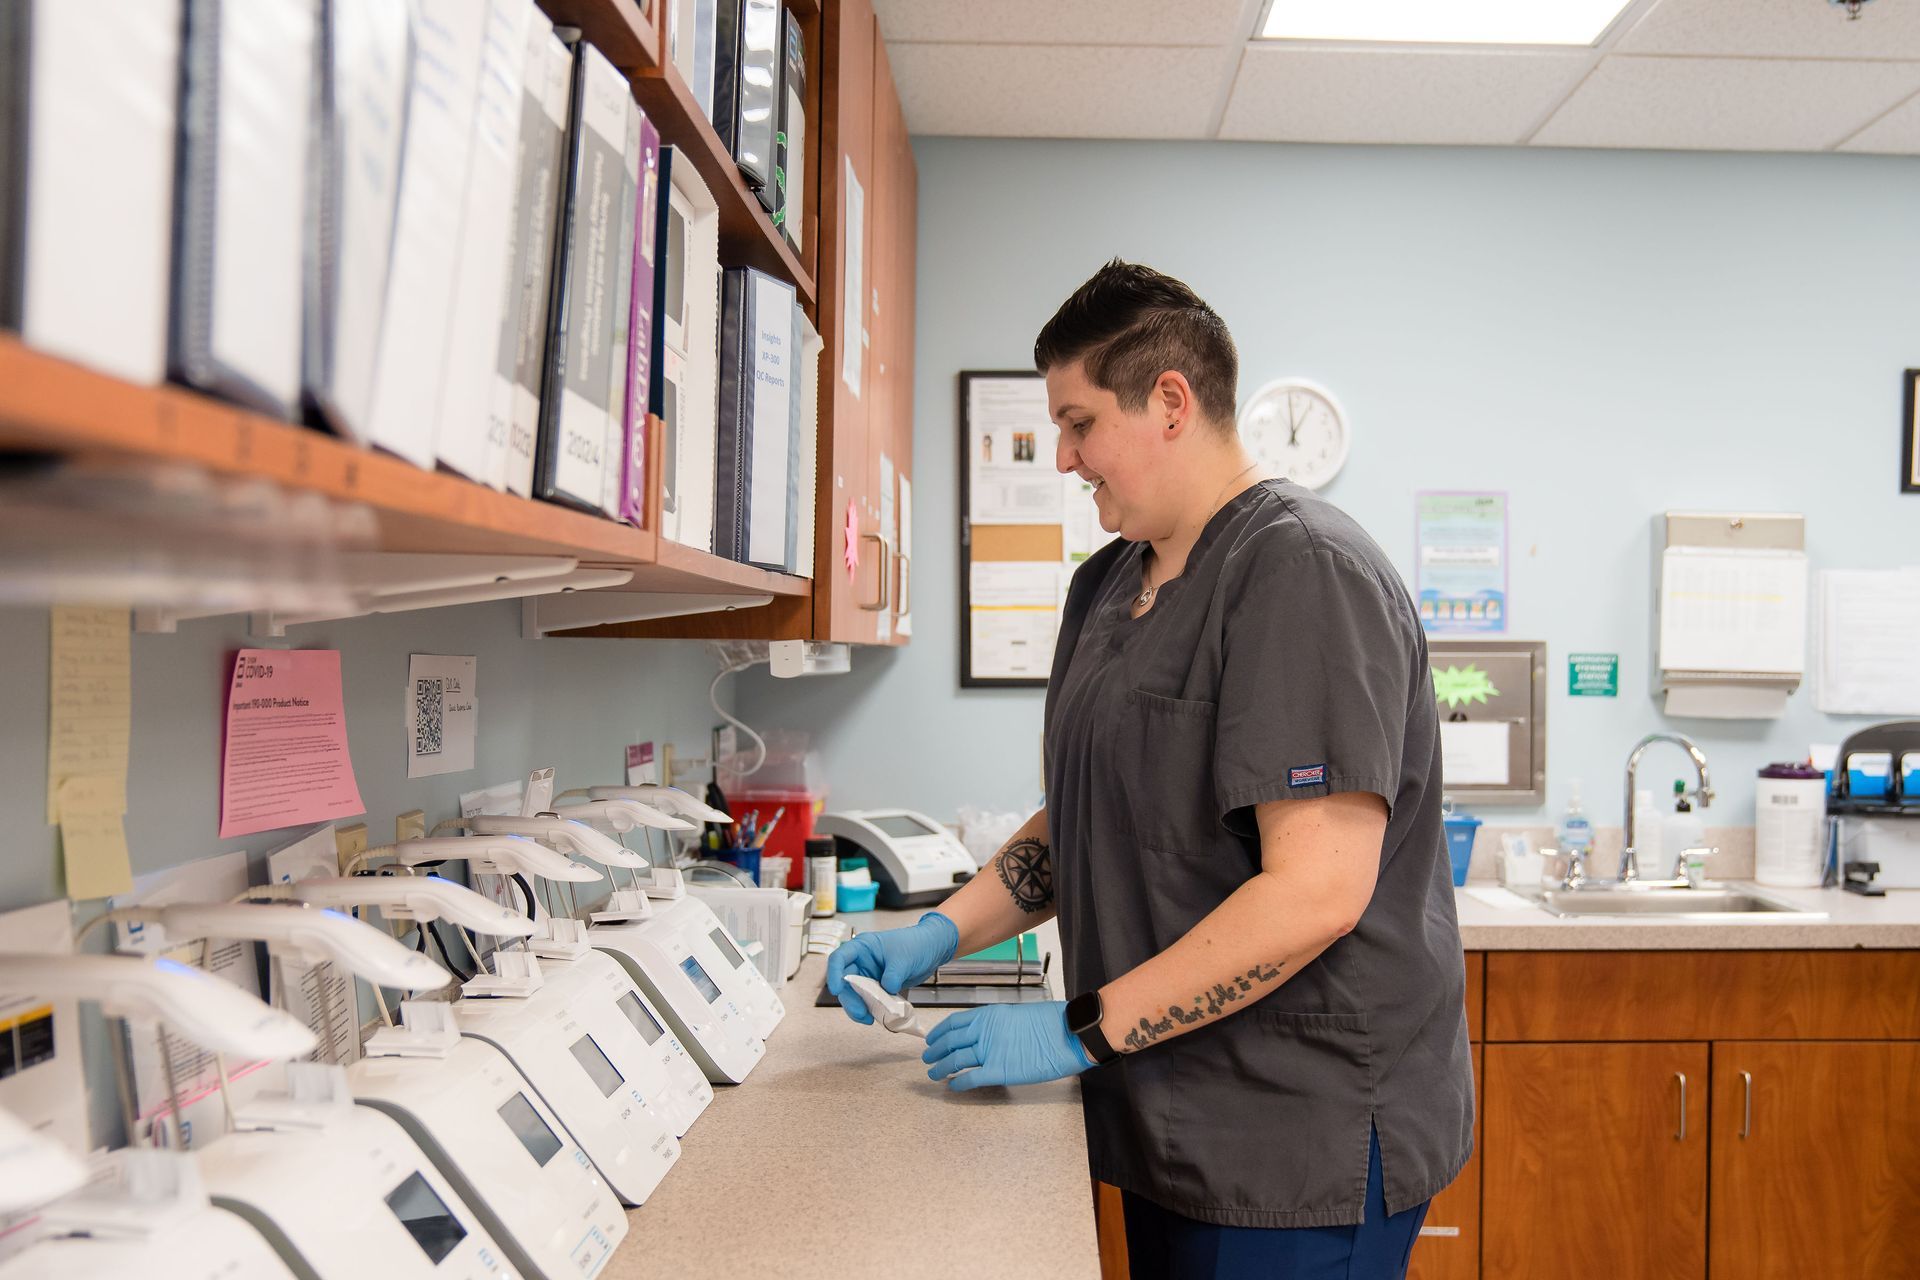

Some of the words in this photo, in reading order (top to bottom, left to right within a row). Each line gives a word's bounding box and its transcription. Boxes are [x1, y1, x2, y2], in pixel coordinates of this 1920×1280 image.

[762, 330, 781, 345] Insights
[762, 351, 780, 365] XP-300
[756, 369, 764, 380] QC
[765, 372, 785, 387] Reports
[245, 665, 273, 679] COVID-19
[273, 698, 291, 708] Product
[292, 697, 309, 707] Notice
